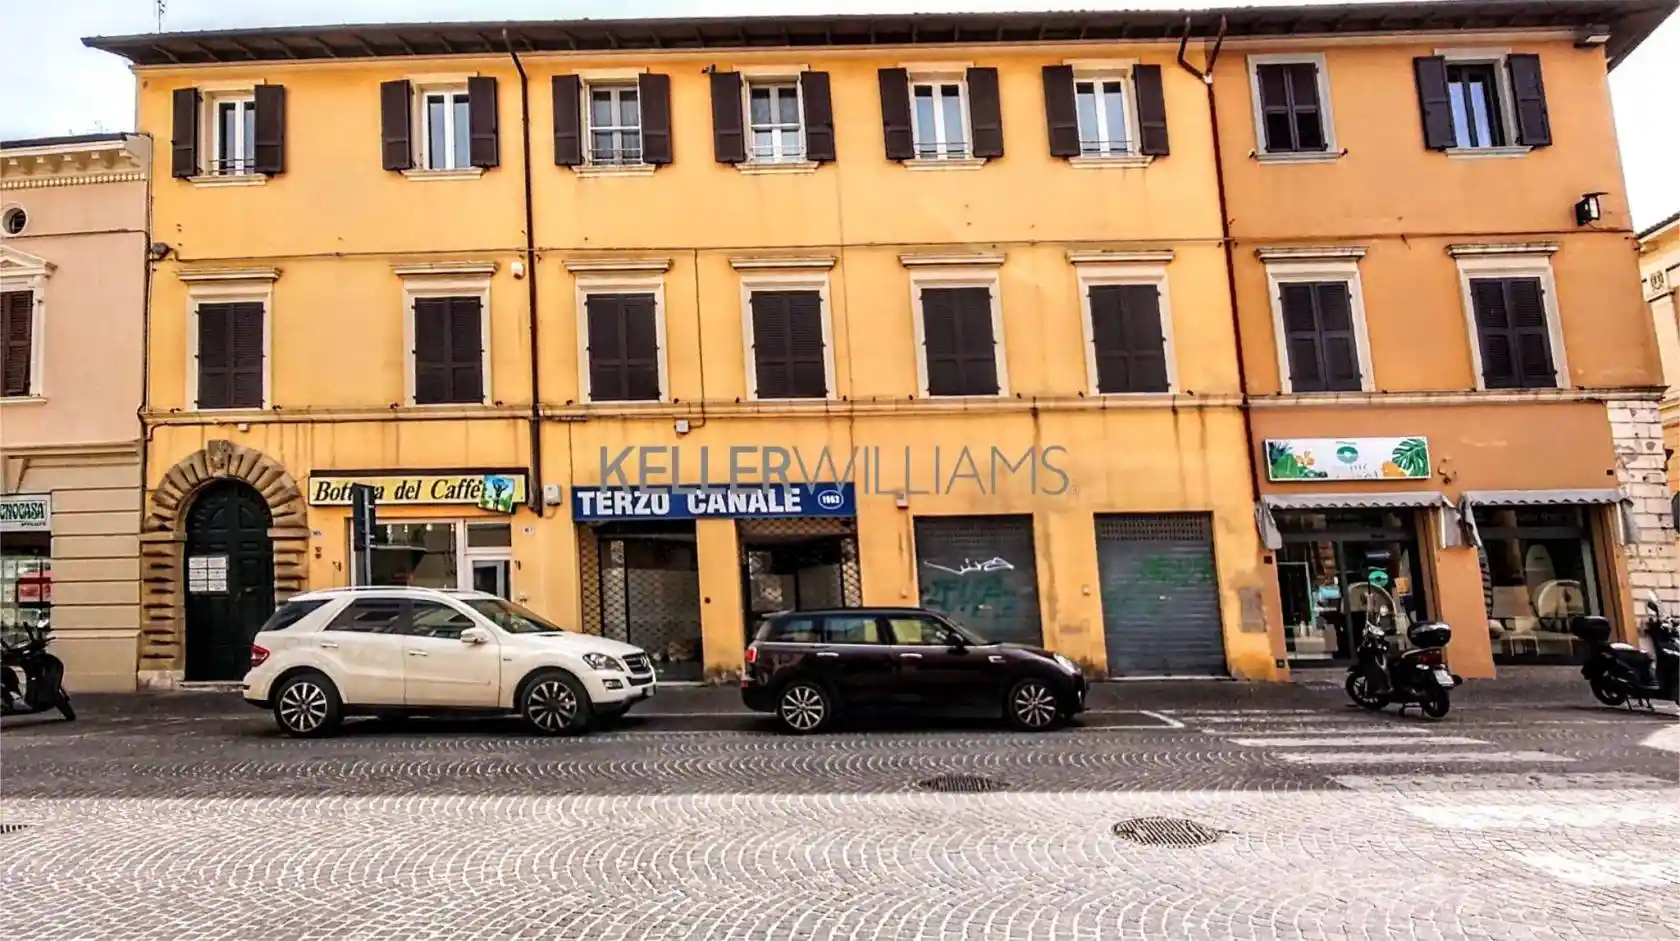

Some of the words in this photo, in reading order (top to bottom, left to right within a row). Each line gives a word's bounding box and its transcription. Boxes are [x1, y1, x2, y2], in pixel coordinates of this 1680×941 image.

[314, 480, 384, 501] Botta
[394, 479, 421, 500] del
[577, 491, 669, 515] TERZO
[687, 488, 802, 514] CANALE
